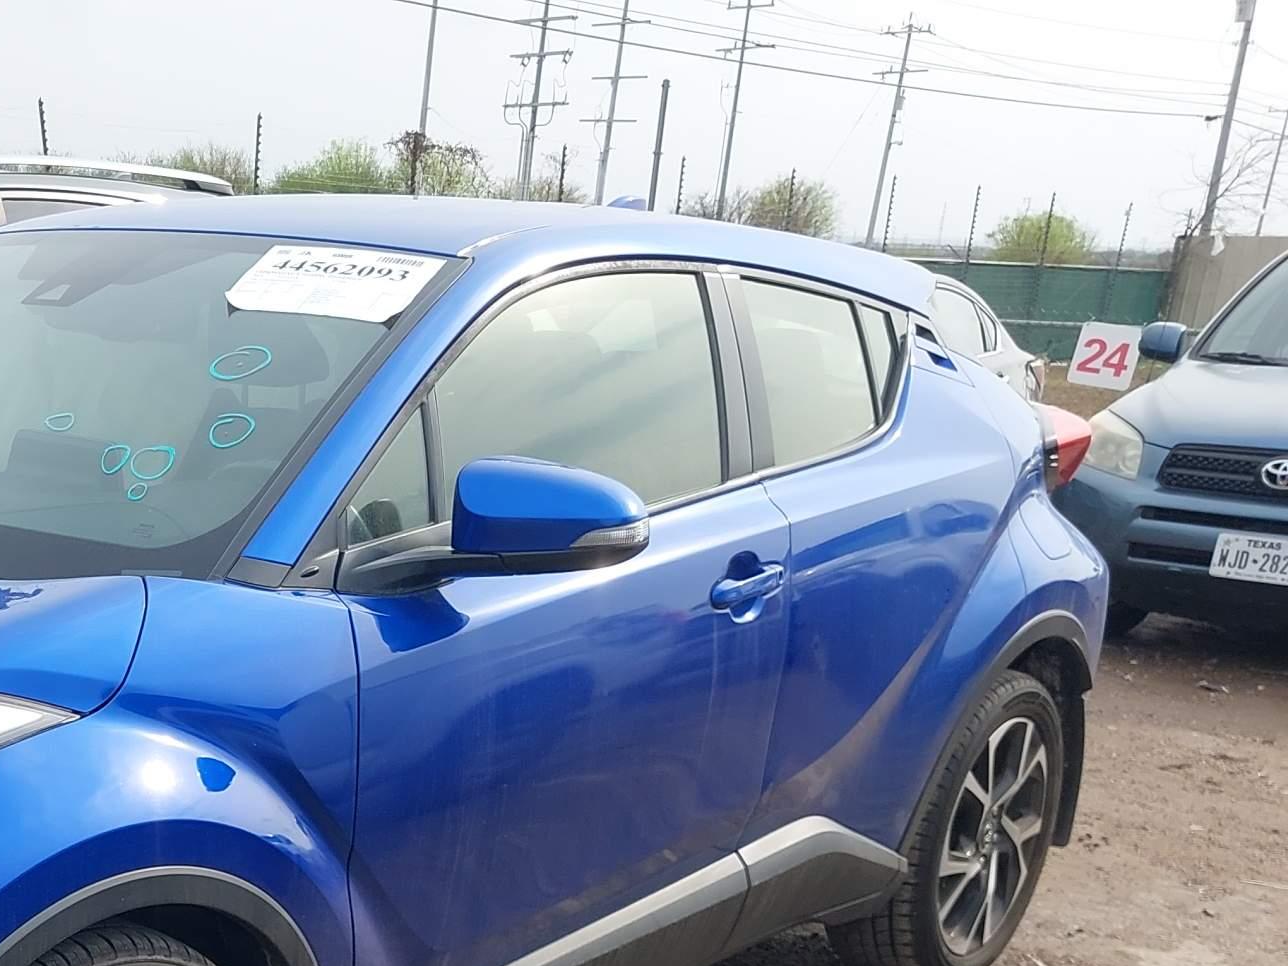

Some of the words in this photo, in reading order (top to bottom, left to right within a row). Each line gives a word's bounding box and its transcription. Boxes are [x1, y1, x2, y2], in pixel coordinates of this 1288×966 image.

[272, 259, 411, 281] 44562093
[1076, 338, 1130, 377] 24
[1246, 539, 1282, 551] TEXAS
